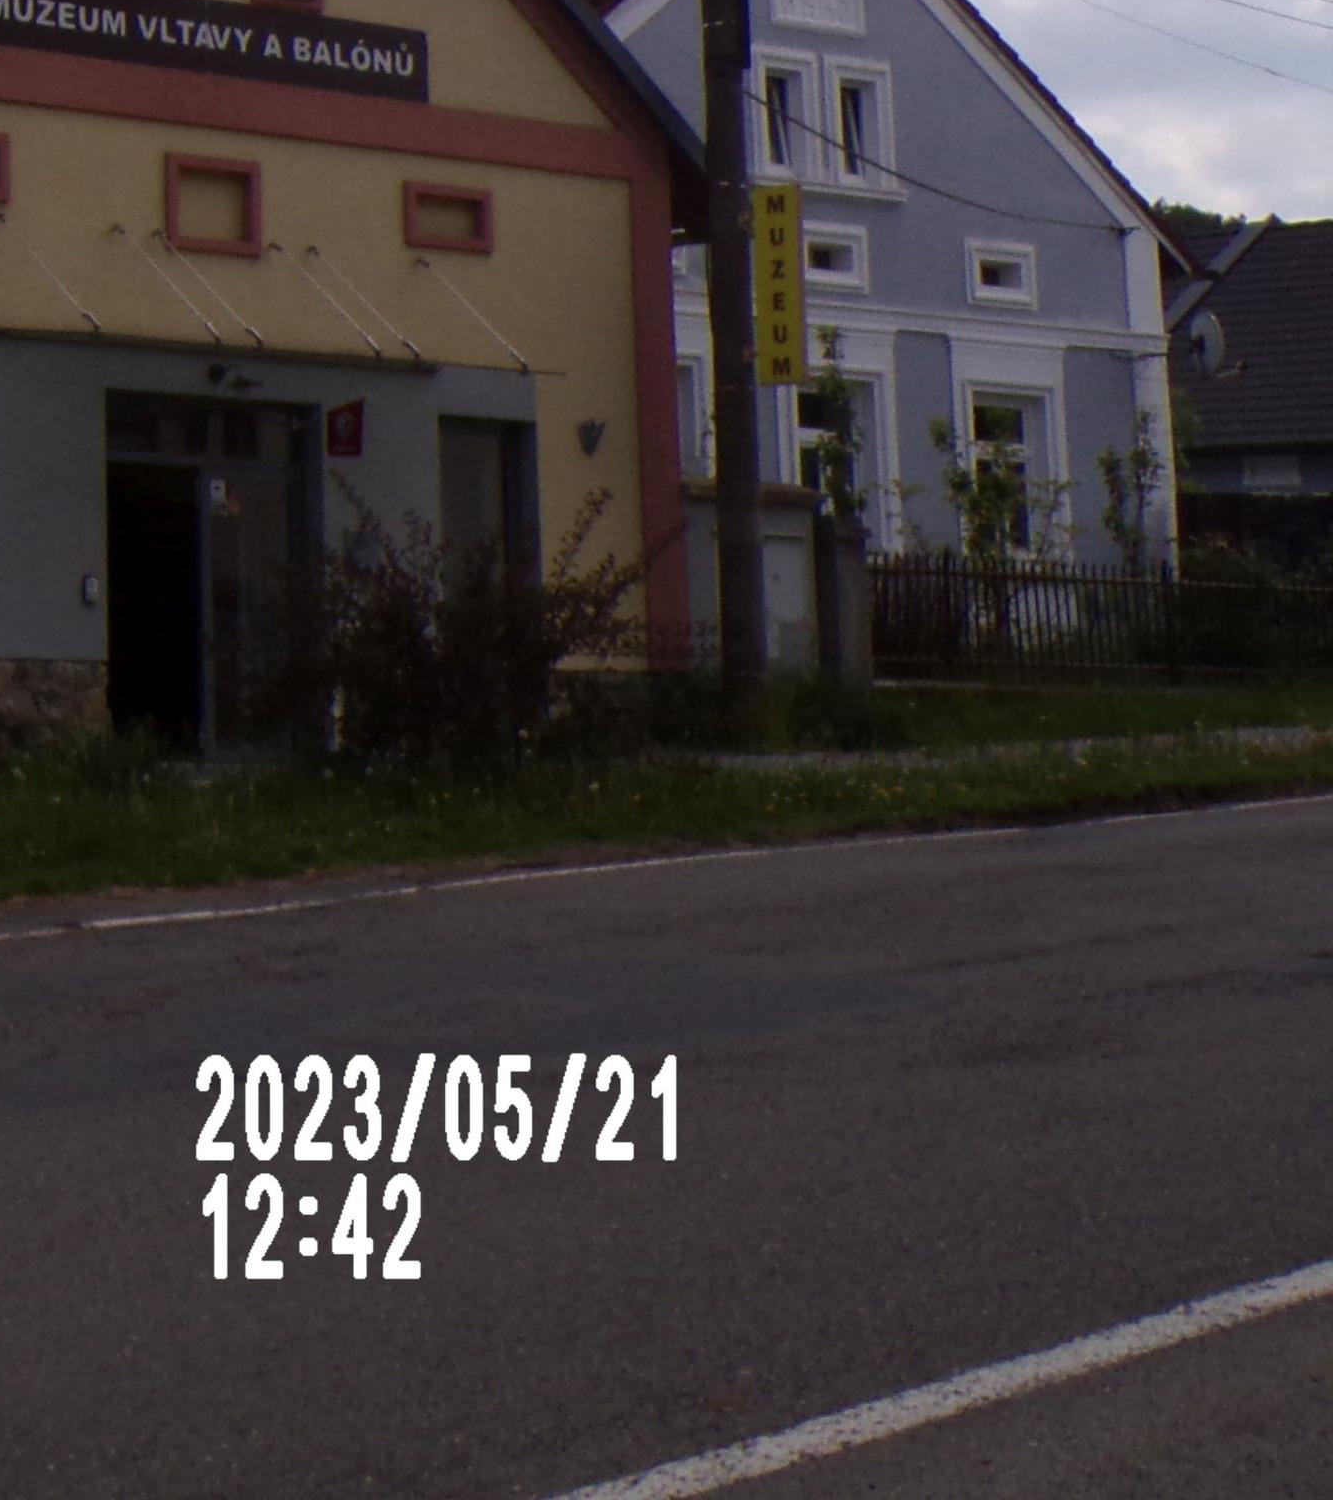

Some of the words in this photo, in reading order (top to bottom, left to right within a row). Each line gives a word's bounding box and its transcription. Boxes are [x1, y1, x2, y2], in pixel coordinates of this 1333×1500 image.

[139, 14, 253, 54] VLTAVY
[263, 36, 283, 59] A
[292, 37, 414, 77] BALÓNŮ
[766, 195, 792, 377] MUZEUM
